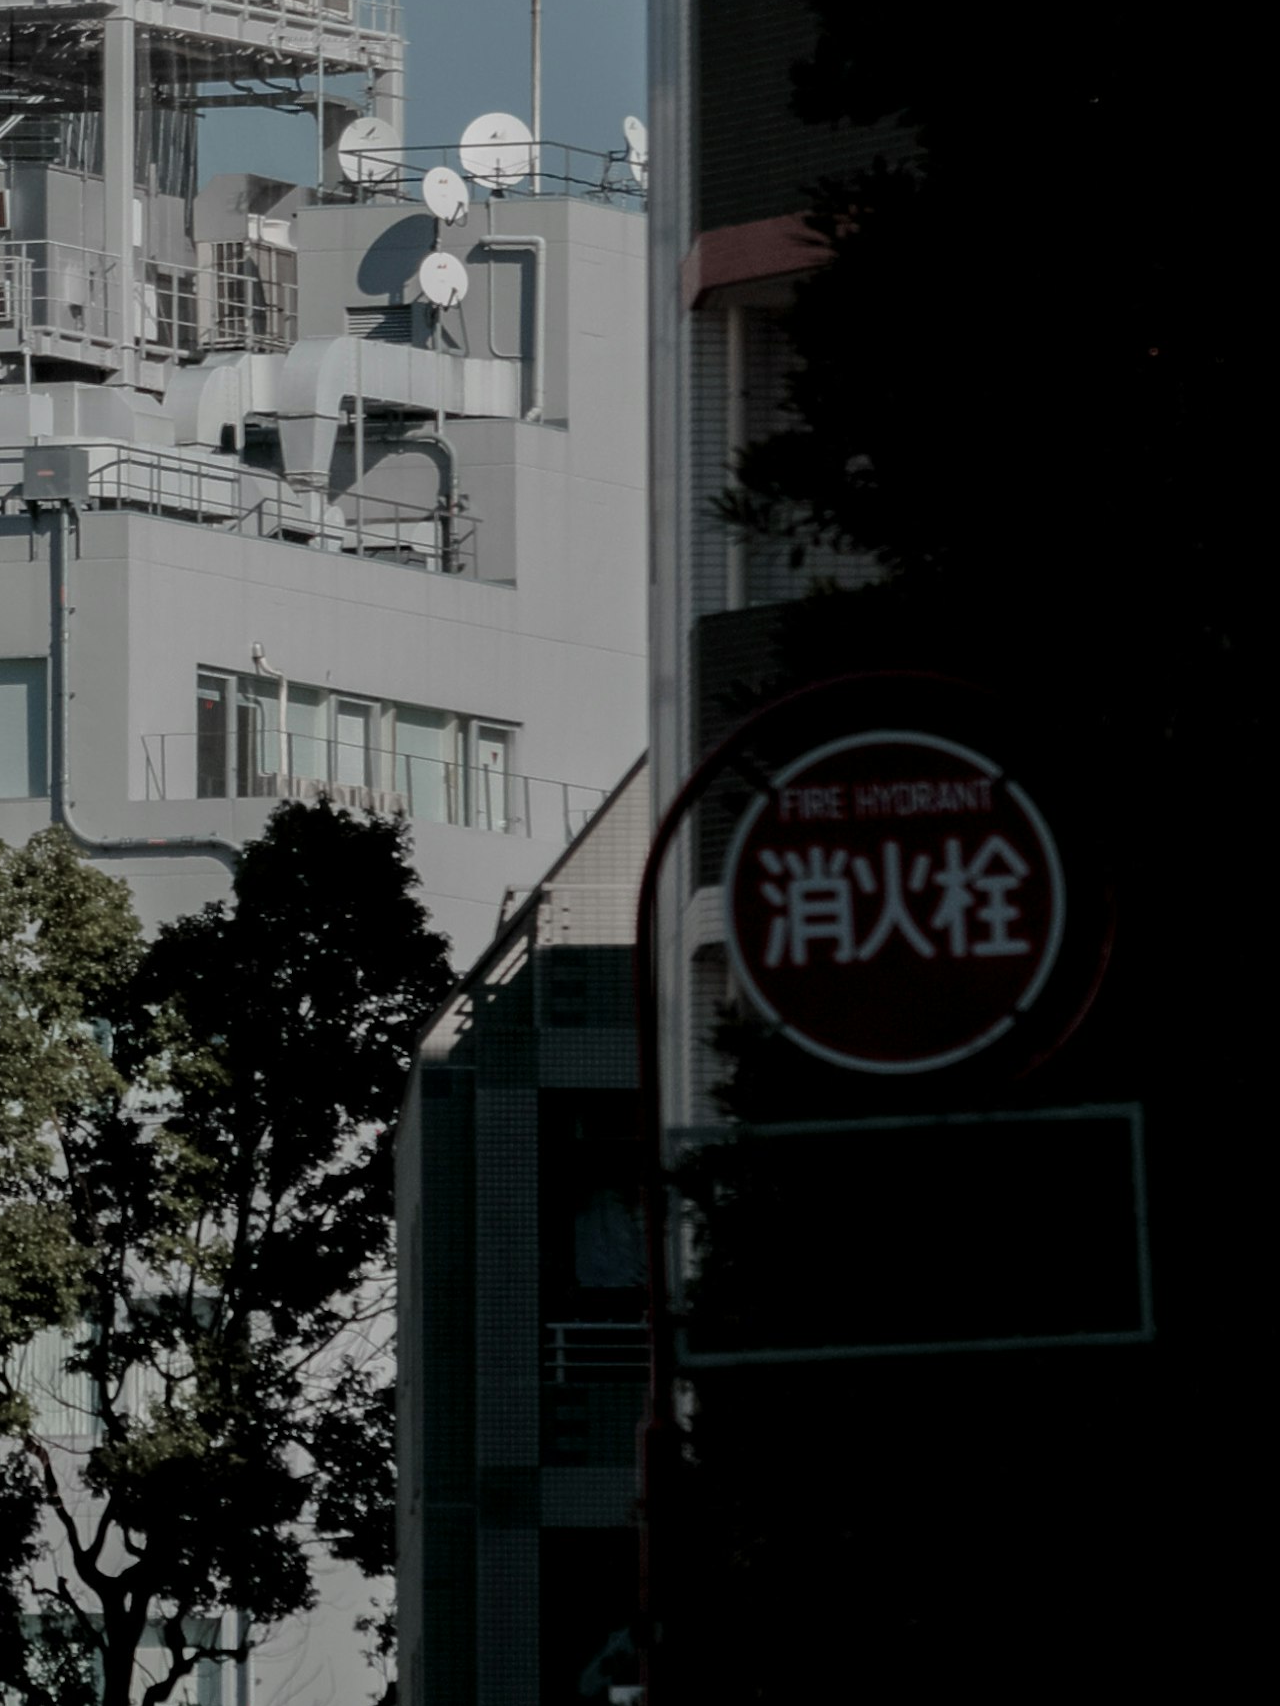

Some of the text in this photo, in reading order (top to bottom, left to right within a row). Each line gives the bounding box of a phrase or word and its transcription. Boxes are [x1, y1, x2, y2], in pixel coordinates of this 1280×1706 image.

[778, 779, 993, 822] FIRE HYDRANT
[756, 833, 1032, 970] 消火栓
